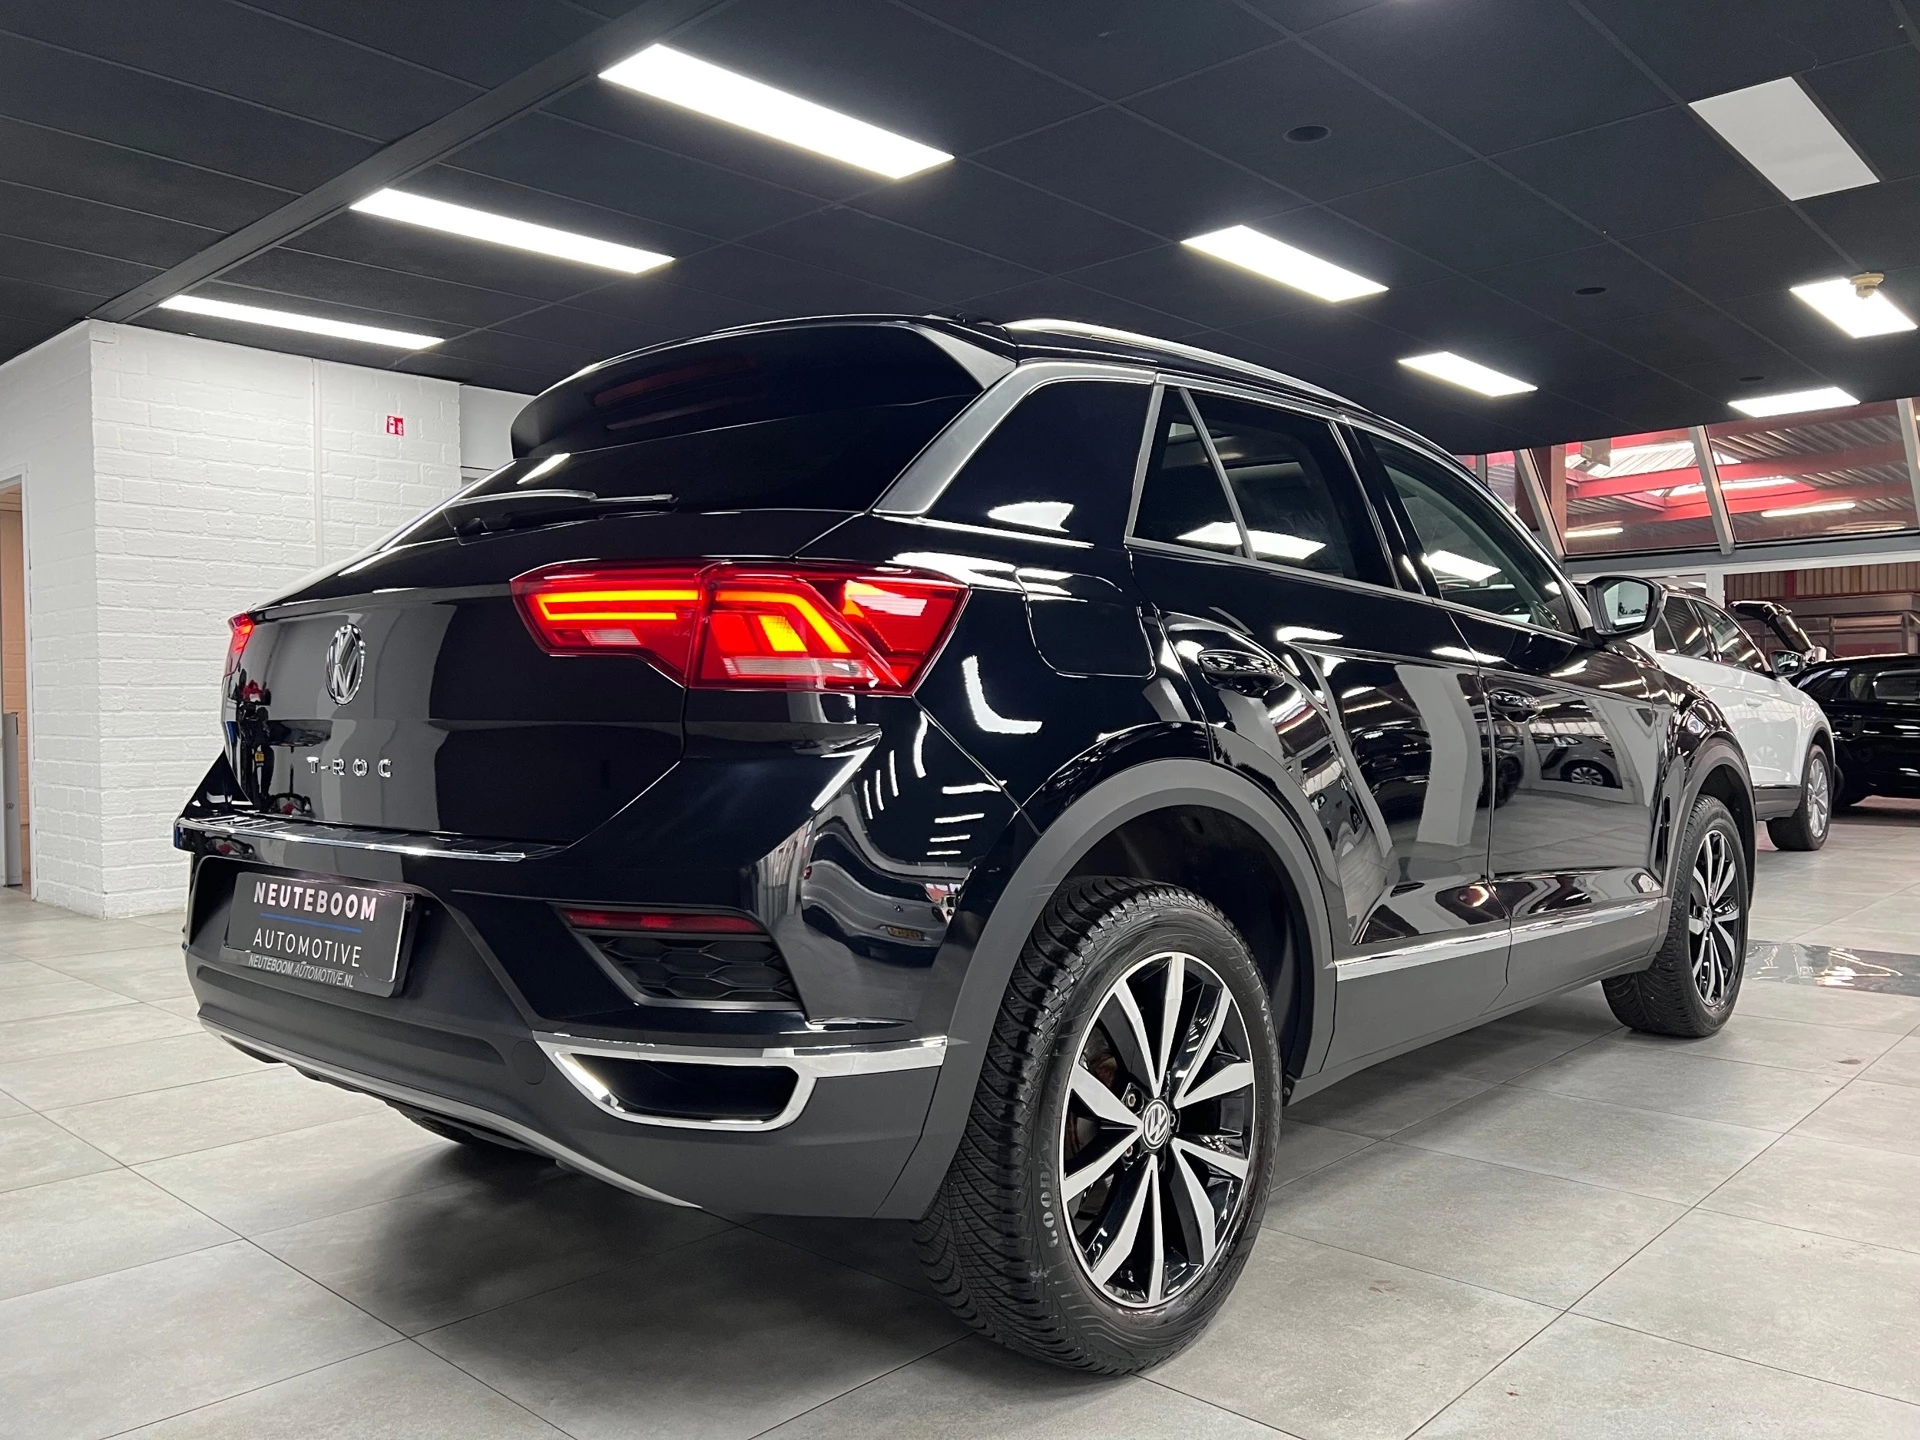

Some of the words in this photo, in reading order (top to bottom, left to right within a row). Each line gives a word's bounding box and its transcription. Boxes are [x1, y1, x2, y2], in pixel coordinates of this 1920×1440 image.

[306, 756, 393, 778] T-ROC
[253, 881, 377, 922] NEUTEBOOM
[253, 927, 362, 968] AUTOMOTIVE
[248, 954, 293, 975] NEUTEBOOM
[293, 963, 354, 988] AUTOMOTIVE.NL
